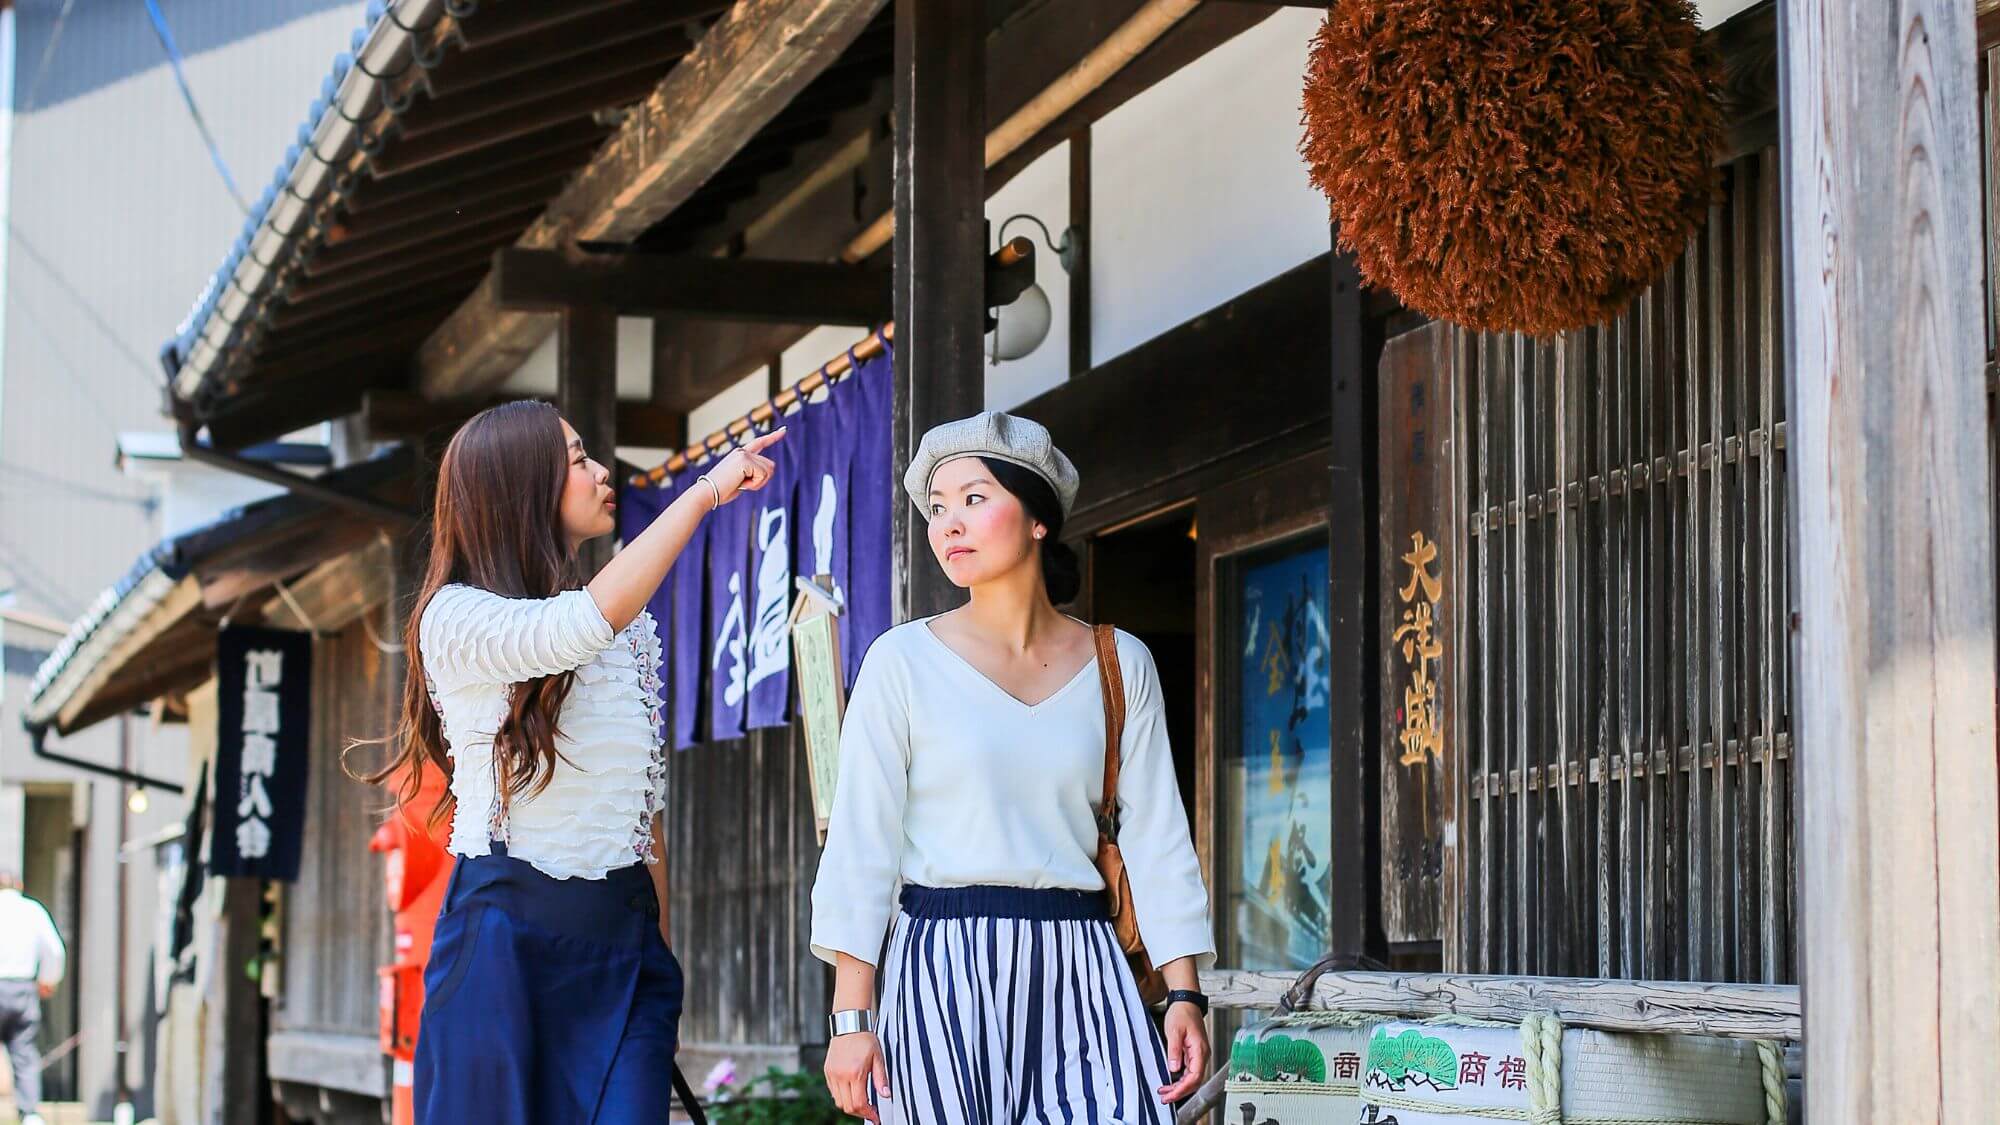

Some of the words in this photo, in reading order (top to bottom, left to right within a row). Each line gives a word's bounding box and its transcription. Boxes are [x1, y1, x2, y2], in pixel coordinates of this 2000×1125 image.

[1393, 530, 1443, 765] 大洋盛
[1333, 1052, 1360, 1080] 商
